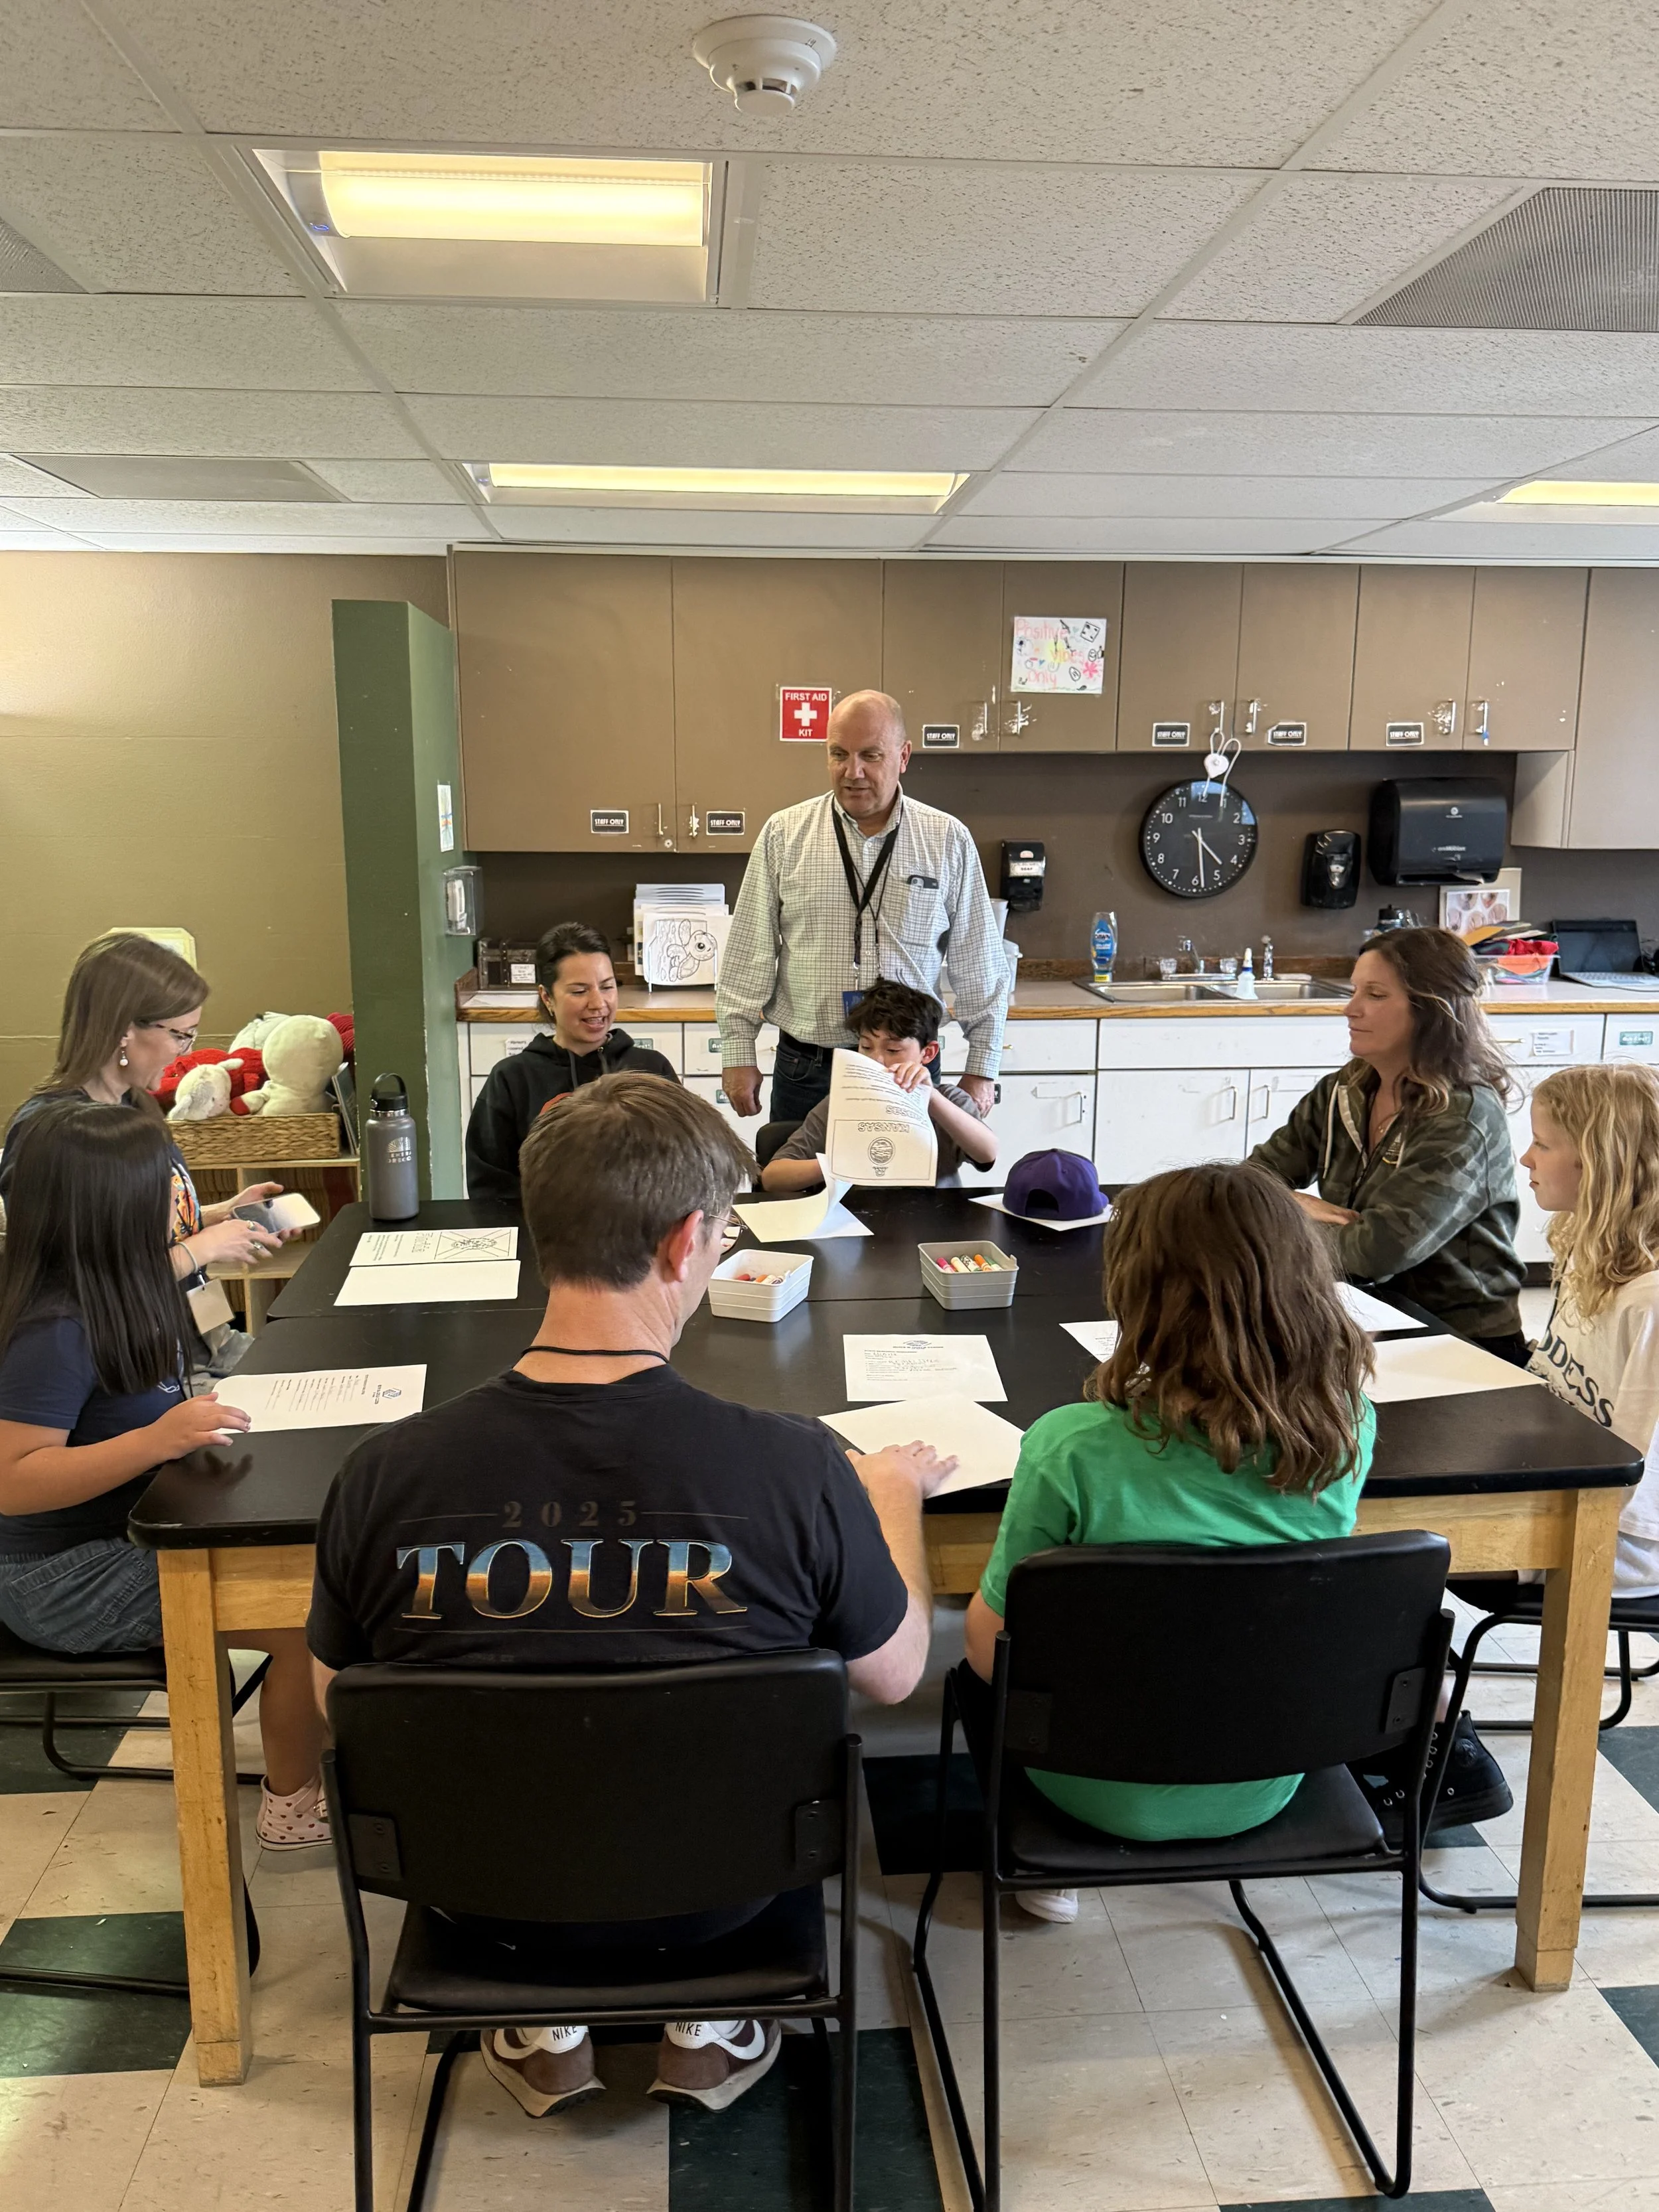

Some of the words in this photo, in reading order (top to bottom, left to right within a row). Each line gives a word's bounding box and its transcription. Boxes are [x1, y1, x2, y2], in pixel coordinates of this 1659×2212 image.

[785, 692, 810, 701] FIRST
[812, 693, 828, 701] AID
[1178, 797, 1187, 808] 11
[1161, 813, 1173, 824] 10
[1233, 813, 1240, 824] 2
[1153, 833, 1160, 843] 9
[1238, 834, 1246, 846] 3
[1157, 853, 1165, 864] 8
[1230, 854, 1238, 865] 4
[1173, 869, 1179, 880] 7
[1192, 875, 1199, 885] 6
[1213, 869, 1220, 881] 5
[857, 1122, 910, 1133] KANSAS
[503, 1501, 636, 1527] 2025
[396, 1538, 748, 1619] TOUR
[552, 2025, 577, 2041] NIKE
[676, 2022, 701, 2037] NIKE
